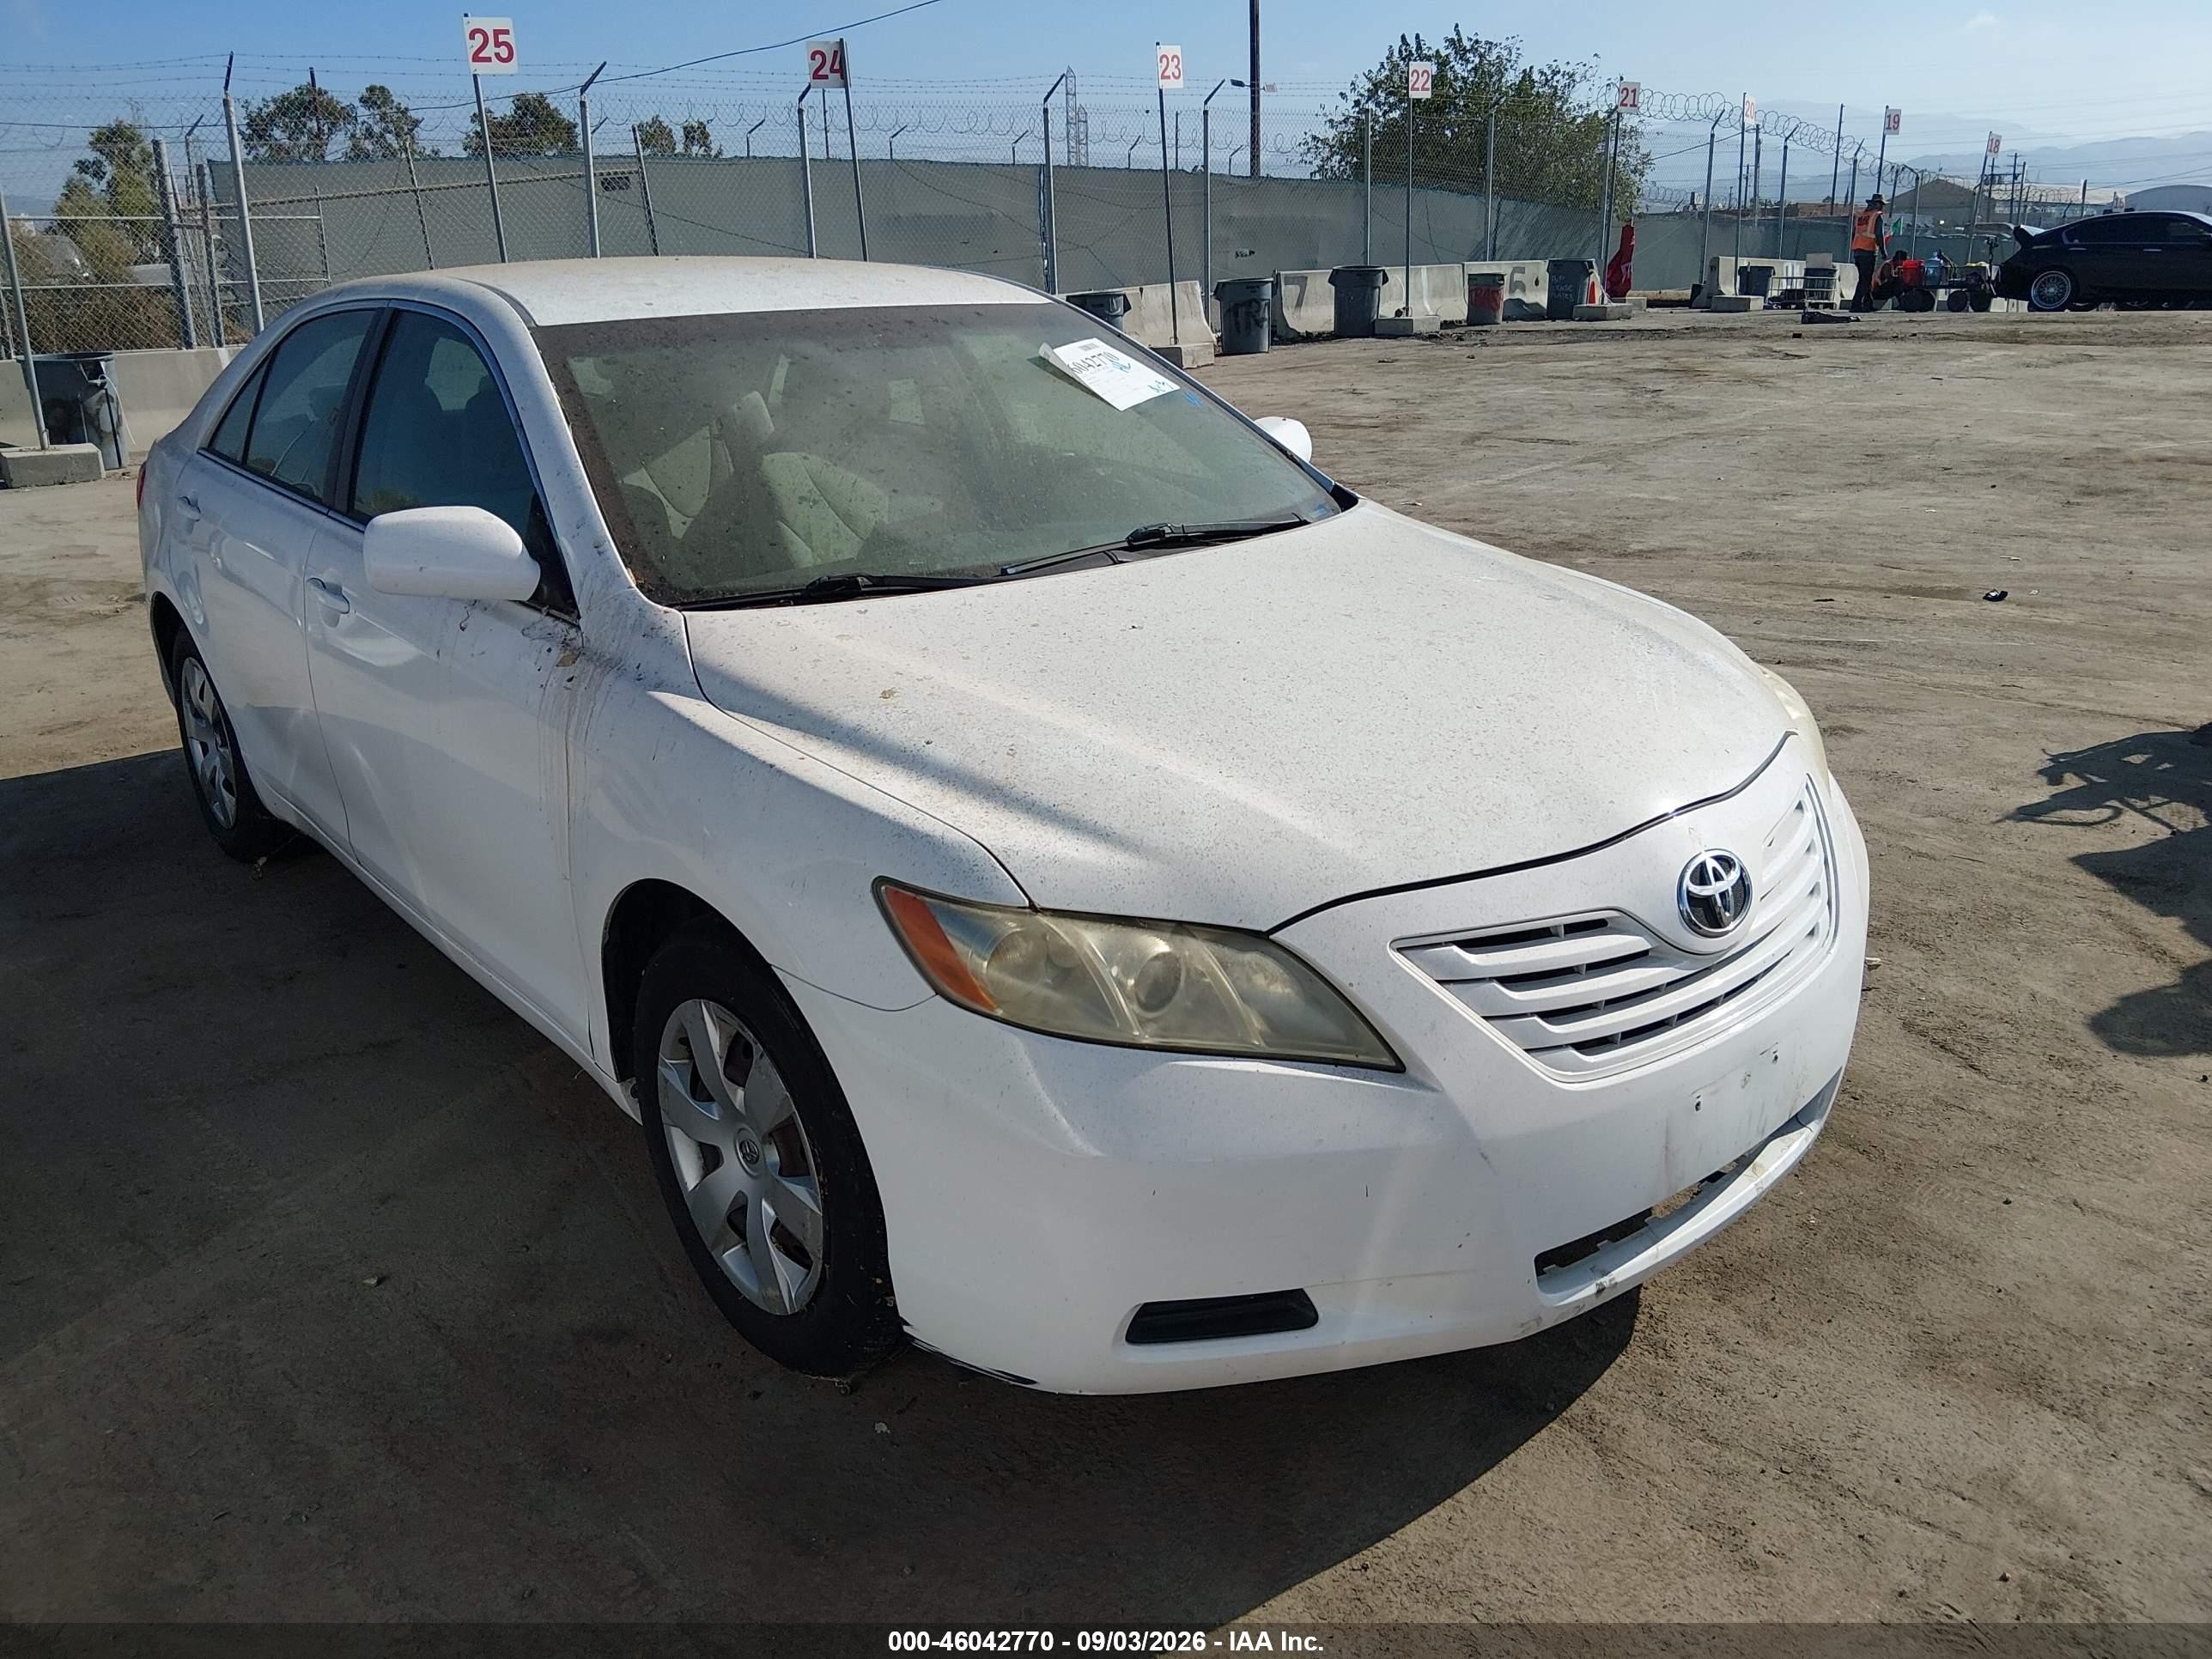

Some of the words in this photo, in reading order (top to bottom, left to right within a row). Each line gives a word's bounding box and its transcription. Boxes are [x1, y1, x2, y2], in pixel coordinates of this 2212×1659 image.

[469, 28, 514, 64] 25
[811, 49, 843, 80] 24
[1159, 54, 1182, 80] 23
[1410, 70, 1430, 91] 22
[1620, 87, 1639, 107] 21
[1745, 100, 1755, 119] 20
[1886, 112, 1900, 131] 19
[1988, 137, 2001, 153] 18
[1509, 266, 1526, 295] 6
[1285, 276, 1308, 317] 7
